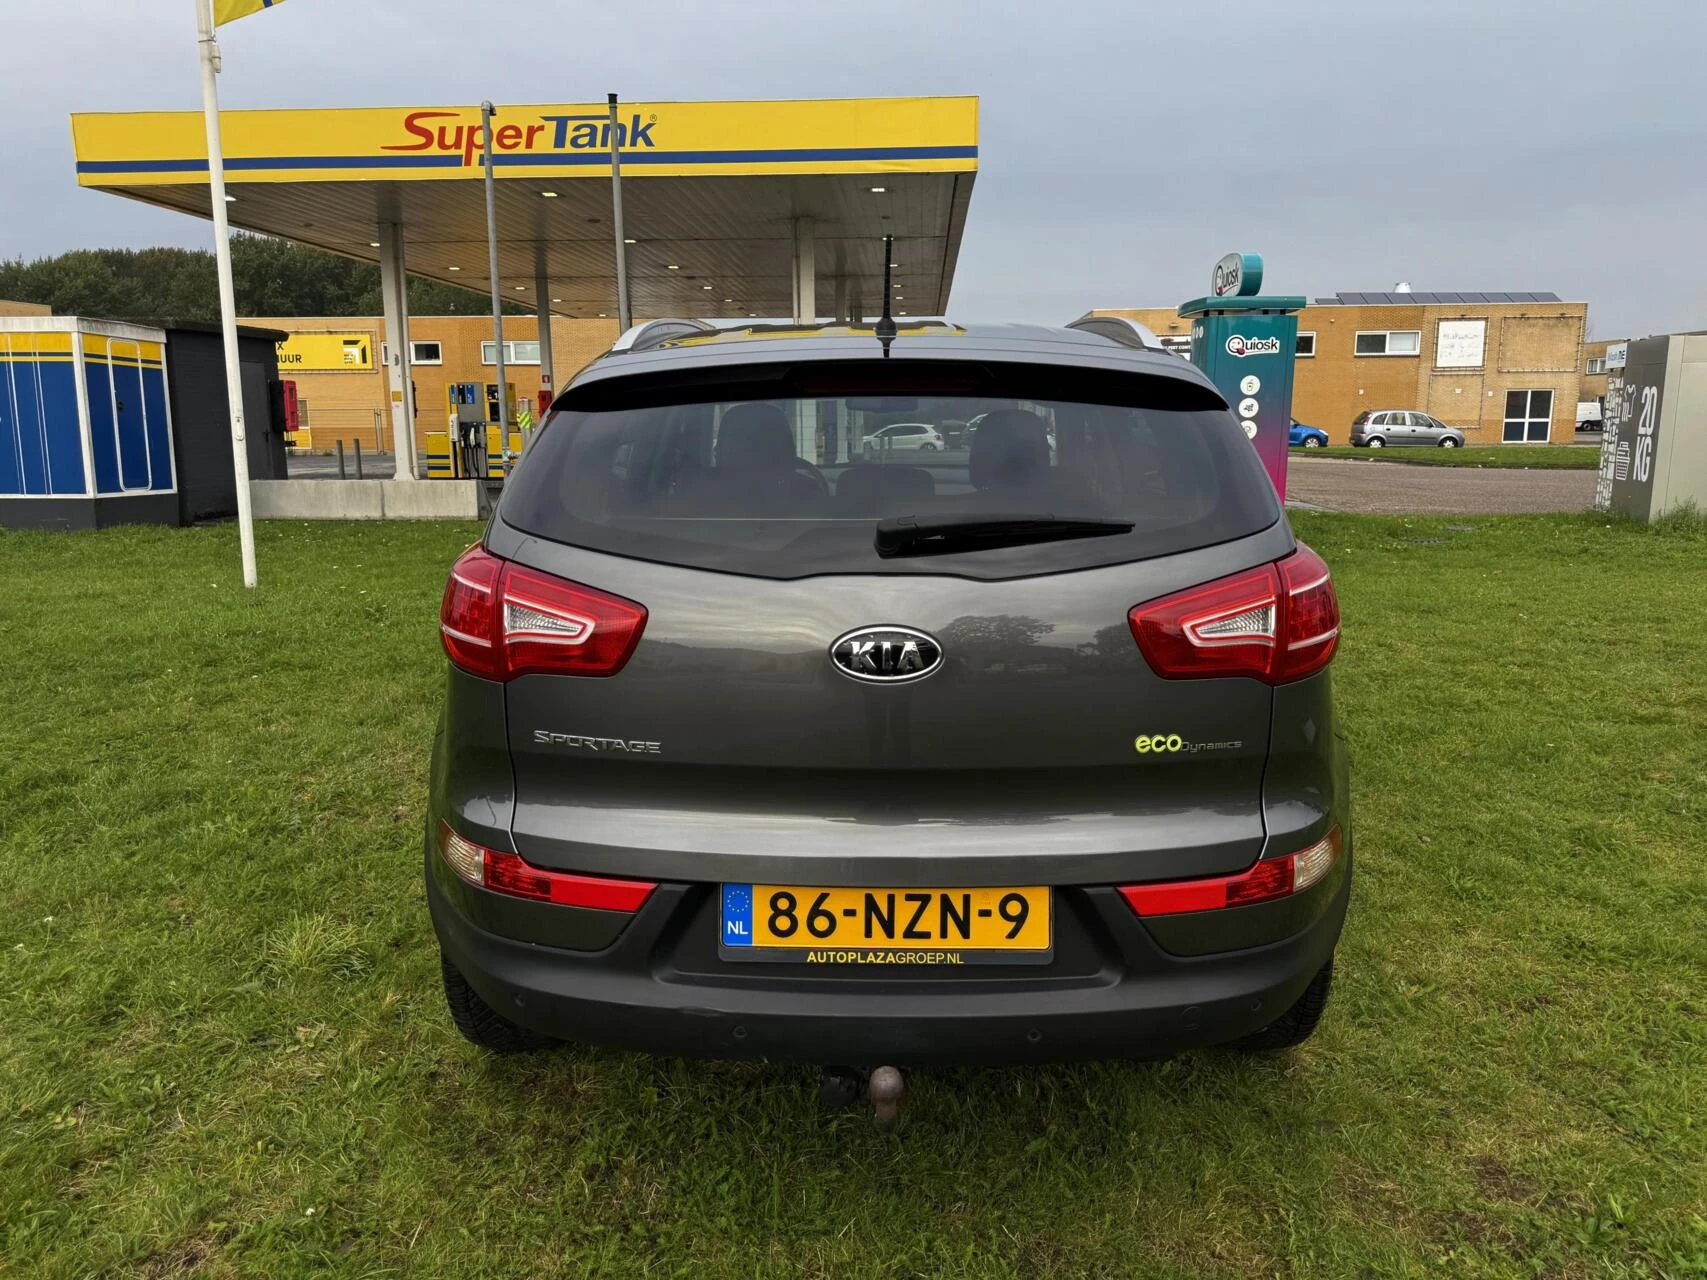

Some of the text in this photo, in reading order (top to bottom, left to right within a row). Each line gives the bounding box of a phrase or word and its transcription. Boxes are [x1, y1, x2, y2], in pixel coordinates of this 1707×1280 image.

[1215, 262, 1239, 296] Quiosk
[1227, 336, 1278, 355] Quiosk
[1638, 386, 1658, 436] 20
[1633, 436, 1652, 483] KG
[850, 641, 924, 669] KIA
[534, 730, 661, 753] SPORTAGE
[727, 921, 748, 935] NL
[768, 891, 1030, 939] 86-NZN-9
[807, 952, 964, 964] AUTOPLAZAGROEP.NL
